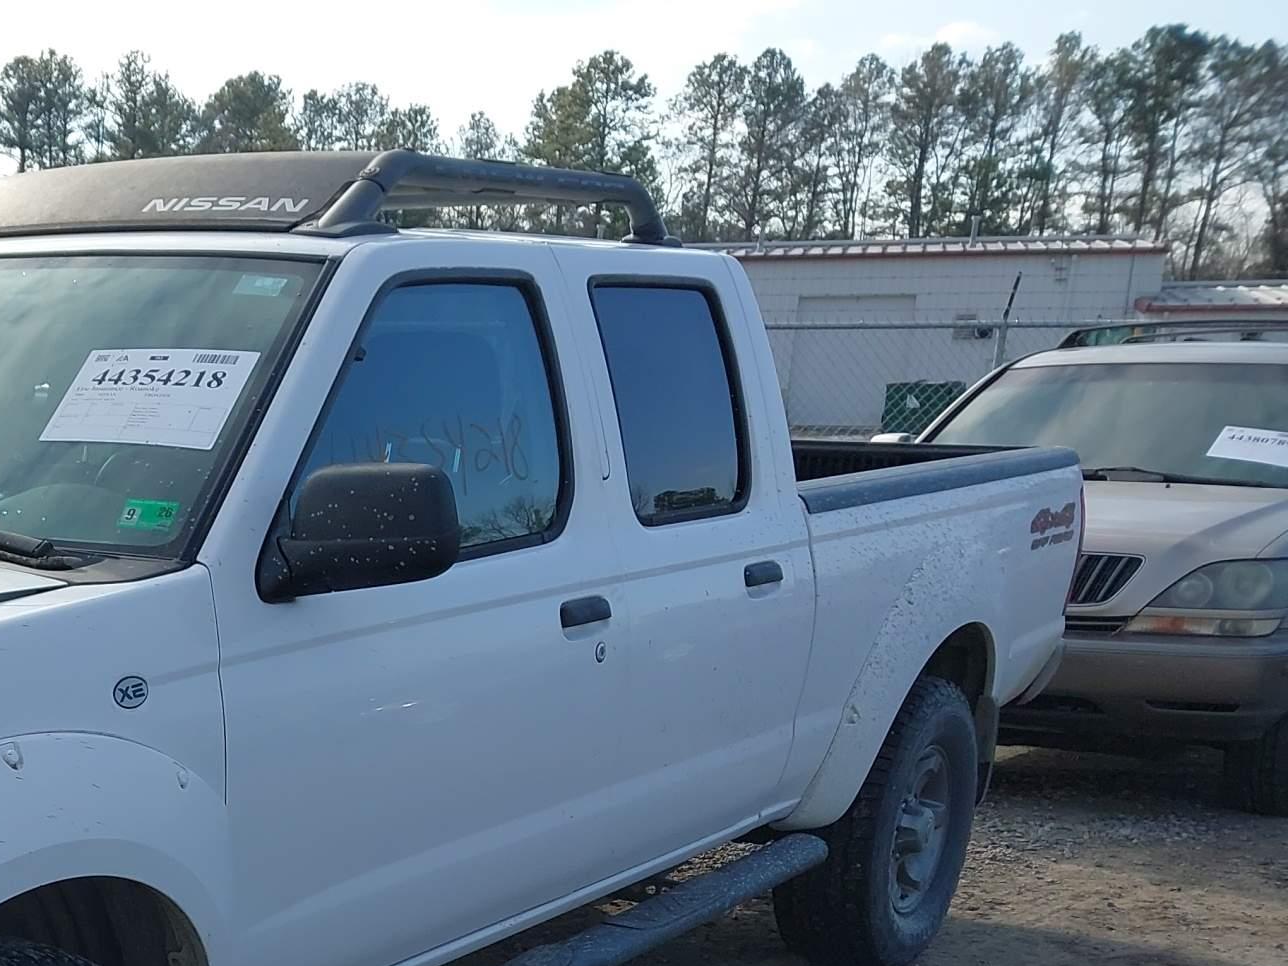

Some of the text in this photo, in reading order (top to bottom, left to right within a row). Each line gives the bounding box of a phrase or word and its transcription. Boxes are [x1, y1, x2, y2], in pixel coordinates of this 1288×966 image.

[142, 197, 309, 212] NISSAN
[92, 368, 227, 389] 44354218
[125, 508, 137, 521] 9
[118, 682, 146, 703] XE
